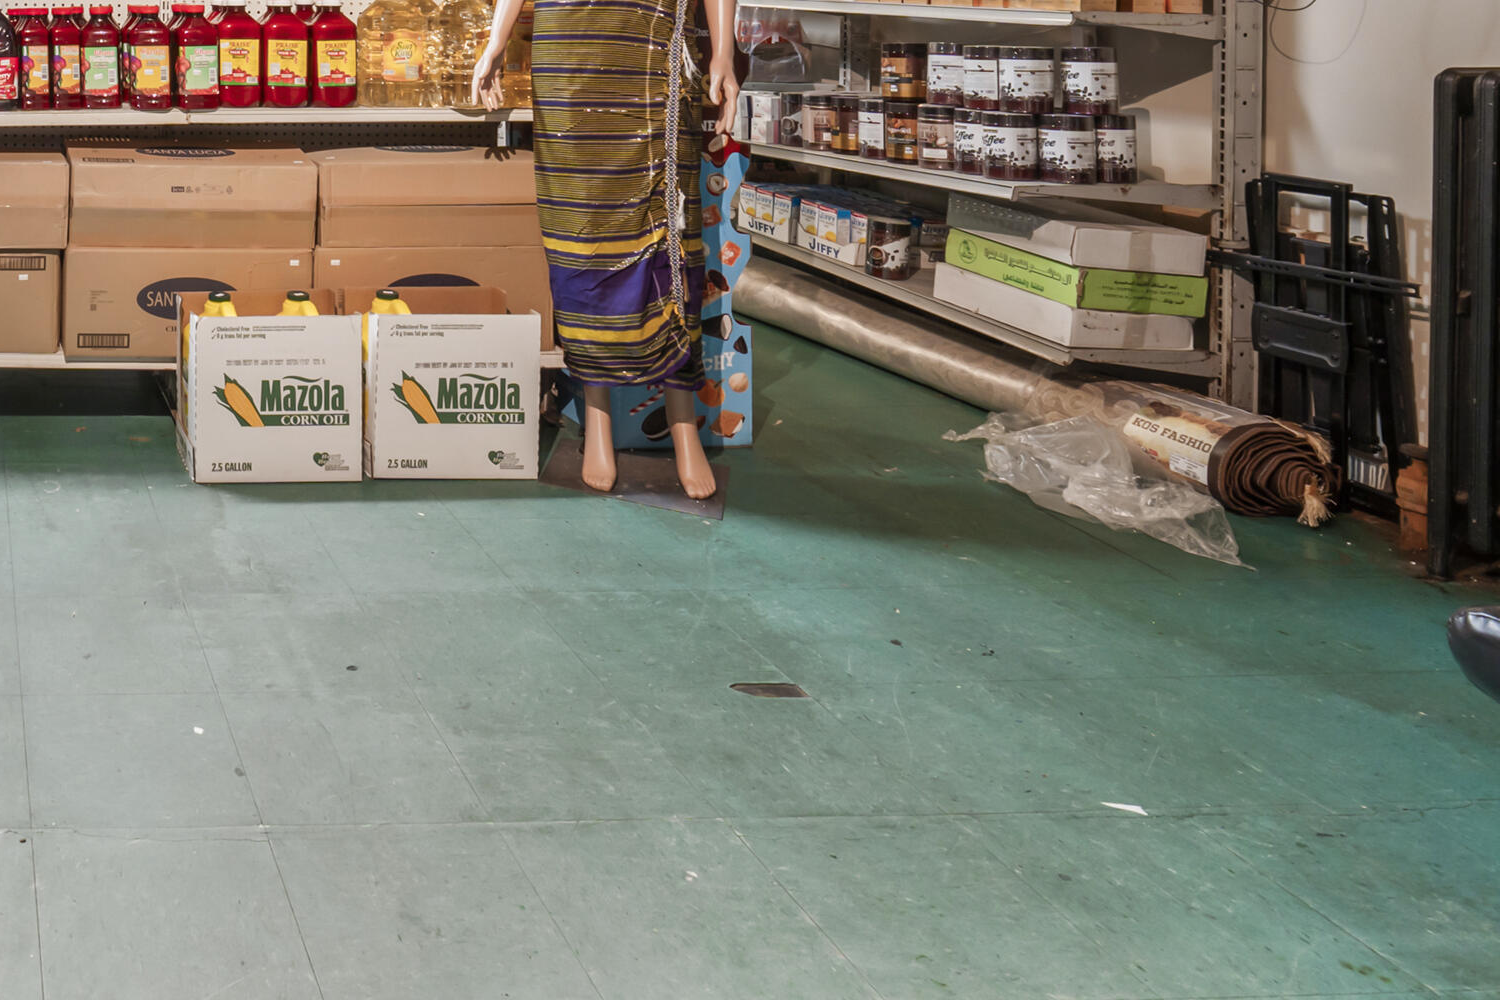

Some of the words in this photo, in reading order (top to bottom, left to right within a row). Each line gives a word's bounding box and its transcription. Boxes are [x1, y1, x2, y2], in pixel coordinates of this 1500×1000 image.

[747, 219, 776, 236] JIFFY
[808, 237, 840, 259] JIFFY
[146, 291, 177, 307] SANT
[260, 379, 345, 412] Mazola
[437, 377, 521, 410] Mazola
[280, 414, 319, 425] CORN
[322, 414, 347, 425] OIL
[457, 412, 495, 423] CORN
[498, 412, 522, 424] OIL
[211, 463, 223, 472] 2.5
[224, 462, 252, 472] GALLON
[388, 459, 399, 468] 2.5
[400, 459, 428, 468] GALLON
